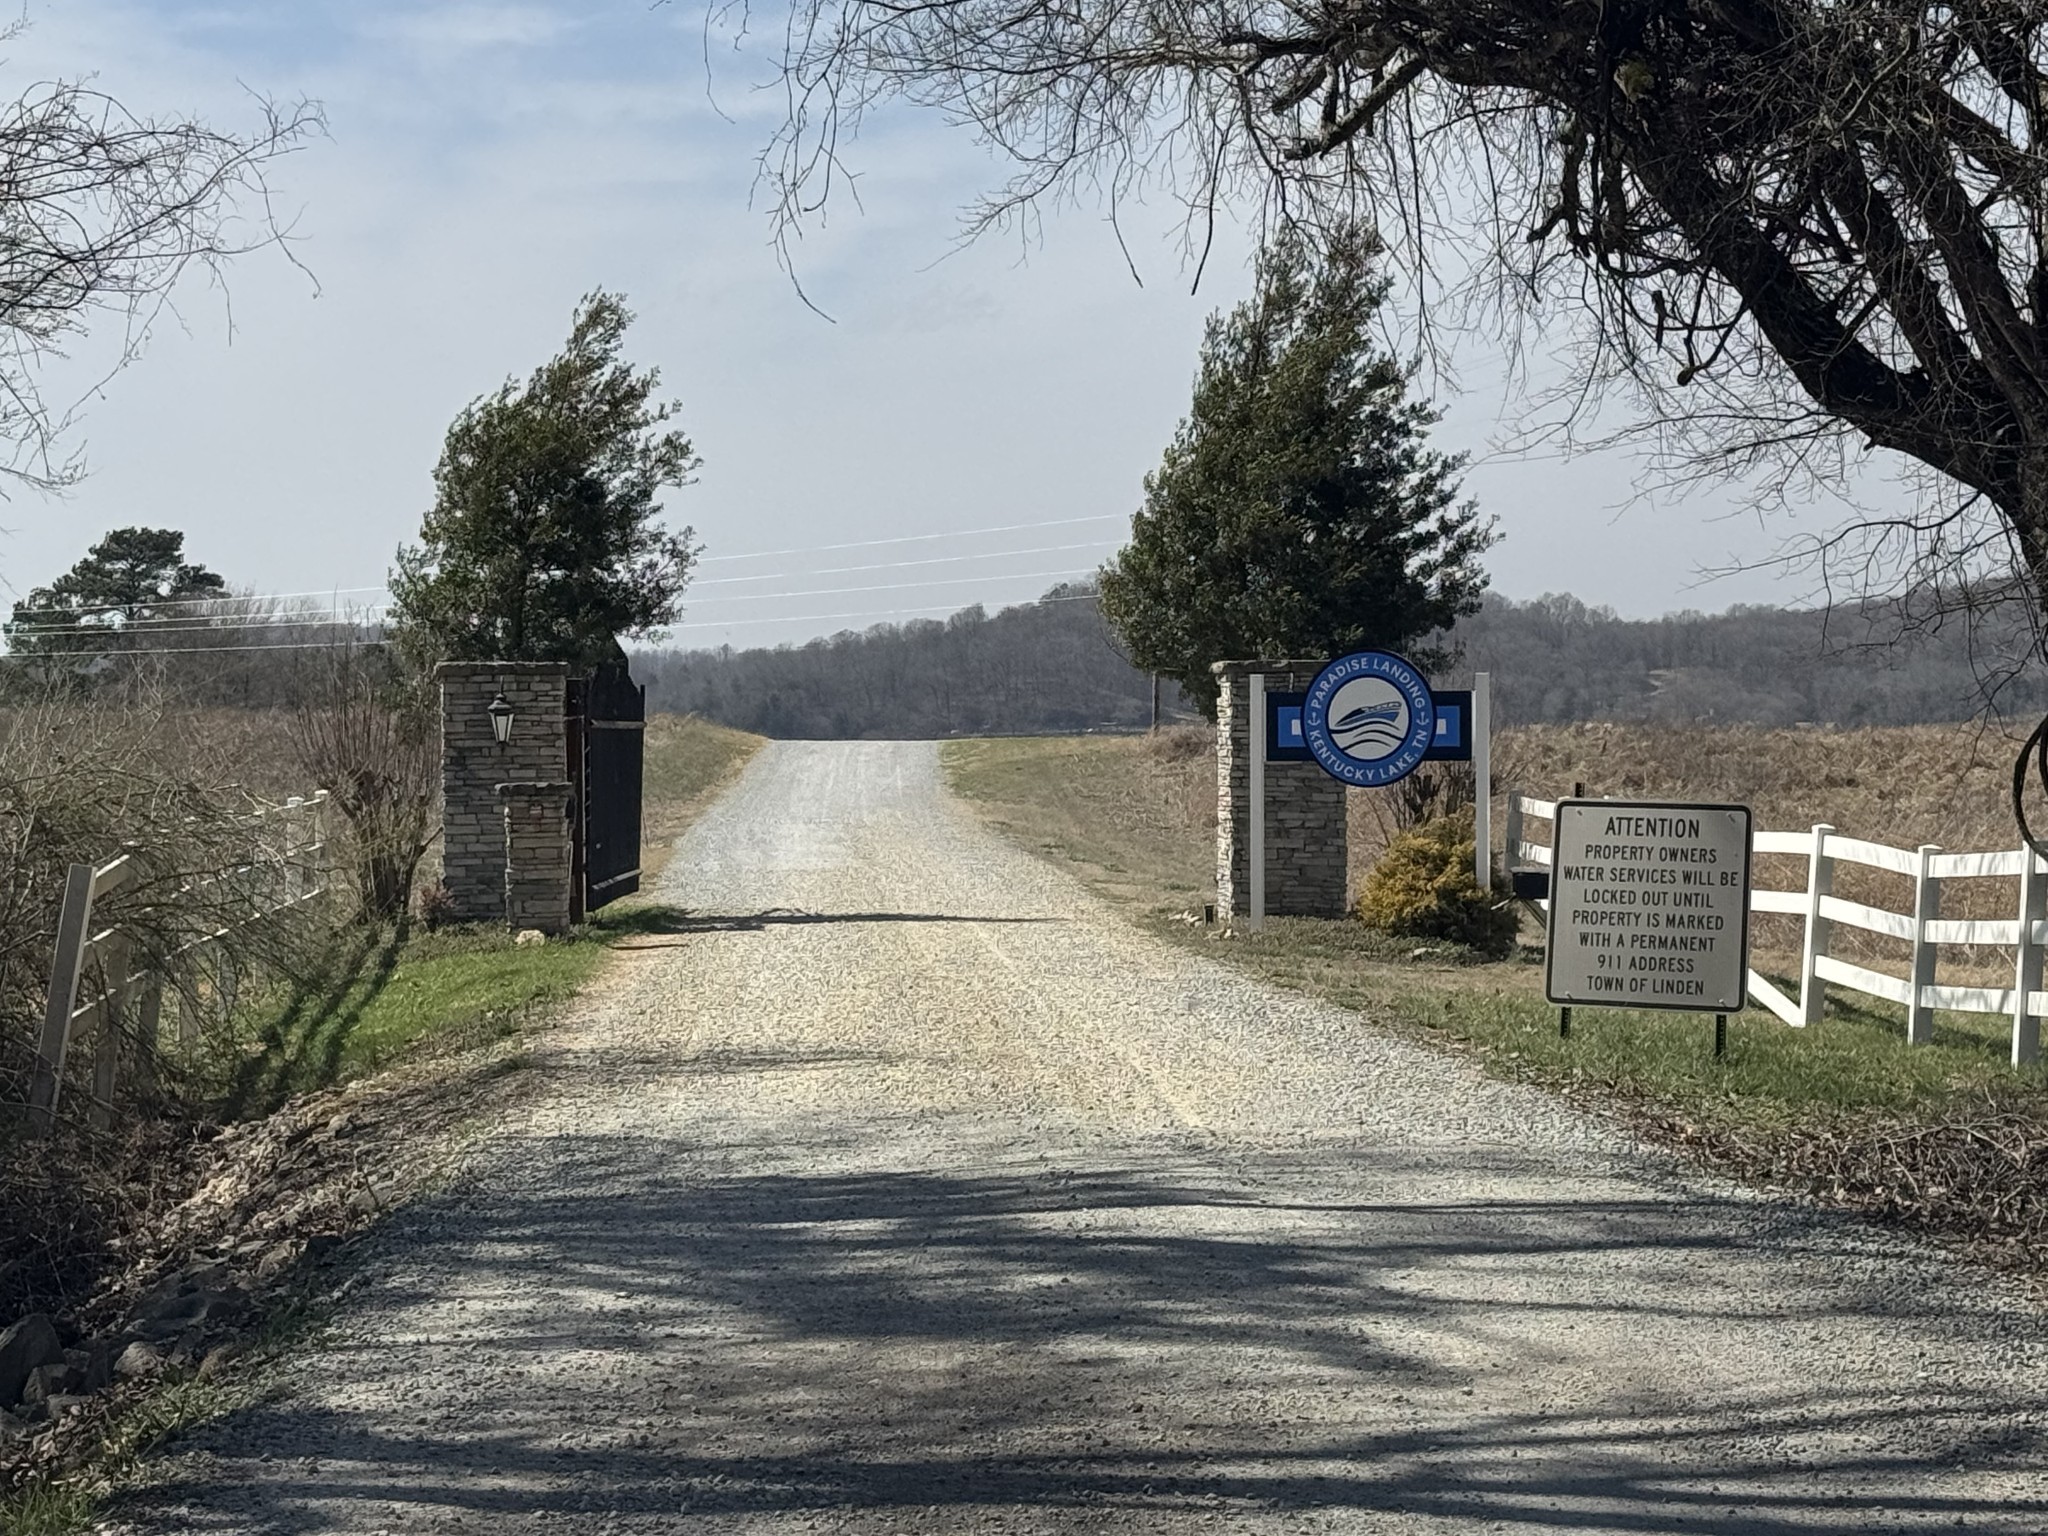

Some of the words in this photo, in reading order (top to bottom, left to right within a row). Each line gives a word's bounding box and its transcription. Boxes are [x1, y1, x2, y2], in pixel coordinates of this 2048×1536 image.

[1311, 657, 1369, 709] PARADISE
[1373, 657, 1425, 709] LANDING
[1309, 730, 1374, 781] KENTUCKY
[1411, 729, 1428, 748] TN
[1604, 816, 1700, 839] ATTENTION
[1584, 844, 1654, 861] PROPERTY
[1659, 847, 1717, 864] OWNERS
[1563, 866, 1604, 882] WATER
[1609, 868, 1676, 884] SERVICES
[1682, 870, 1715, 886] WILL
[1720, 872, 1739, 887] BE
[1583, 889, 1636, 905] LOCKED
[1642, 891, 1668, 906] OUT
[1673, 892, 1714, 908] UNTIL
[1572, 910, 1642, 927] PROPERTY
[1647, 913, 1660, 928] IS
[1665, 914, 1724, 931] MARKED
[1579, 932, 1611, 948] WITH
[1616, 933, 1625, 948] A
[1630, 934, 1716, 952] PERMANENT
[1597, 954, 1621, 970] 911
[1629, 956, 1694, 973] ADDRESS
[1587, 975, 1624, 992] TOWN
[1629, 977, 1648, 992] OF
[1652, 979, 1704, 996] LINDEN
